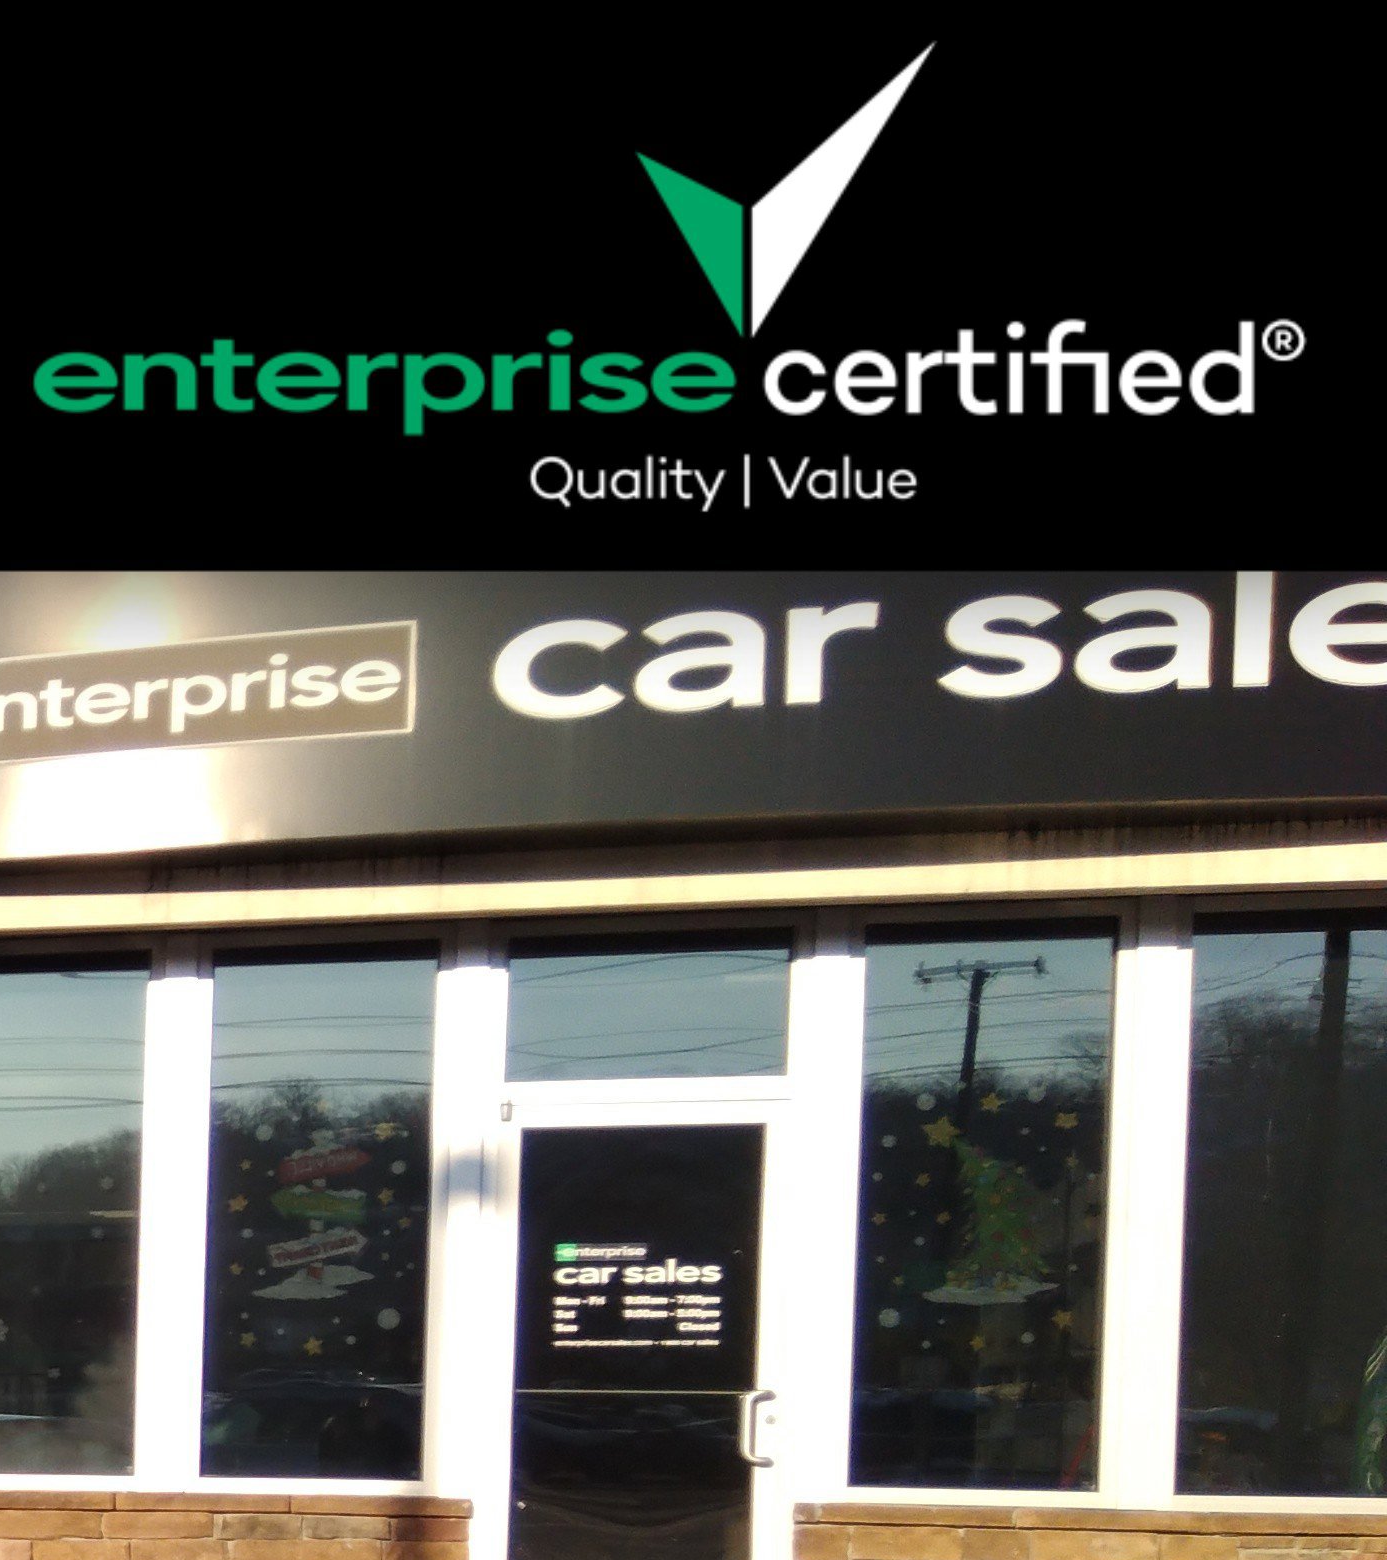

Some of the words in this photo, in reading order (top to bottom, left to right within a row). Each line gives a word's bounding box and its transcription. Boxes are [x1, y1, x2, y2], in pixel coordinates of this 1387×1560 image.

[491, 606, 880, 720] car
[559, 1245, 646, 1260] enterprise
[553, 1265, 619, 1285] car
[621, 1258, 723, 1285] sales
